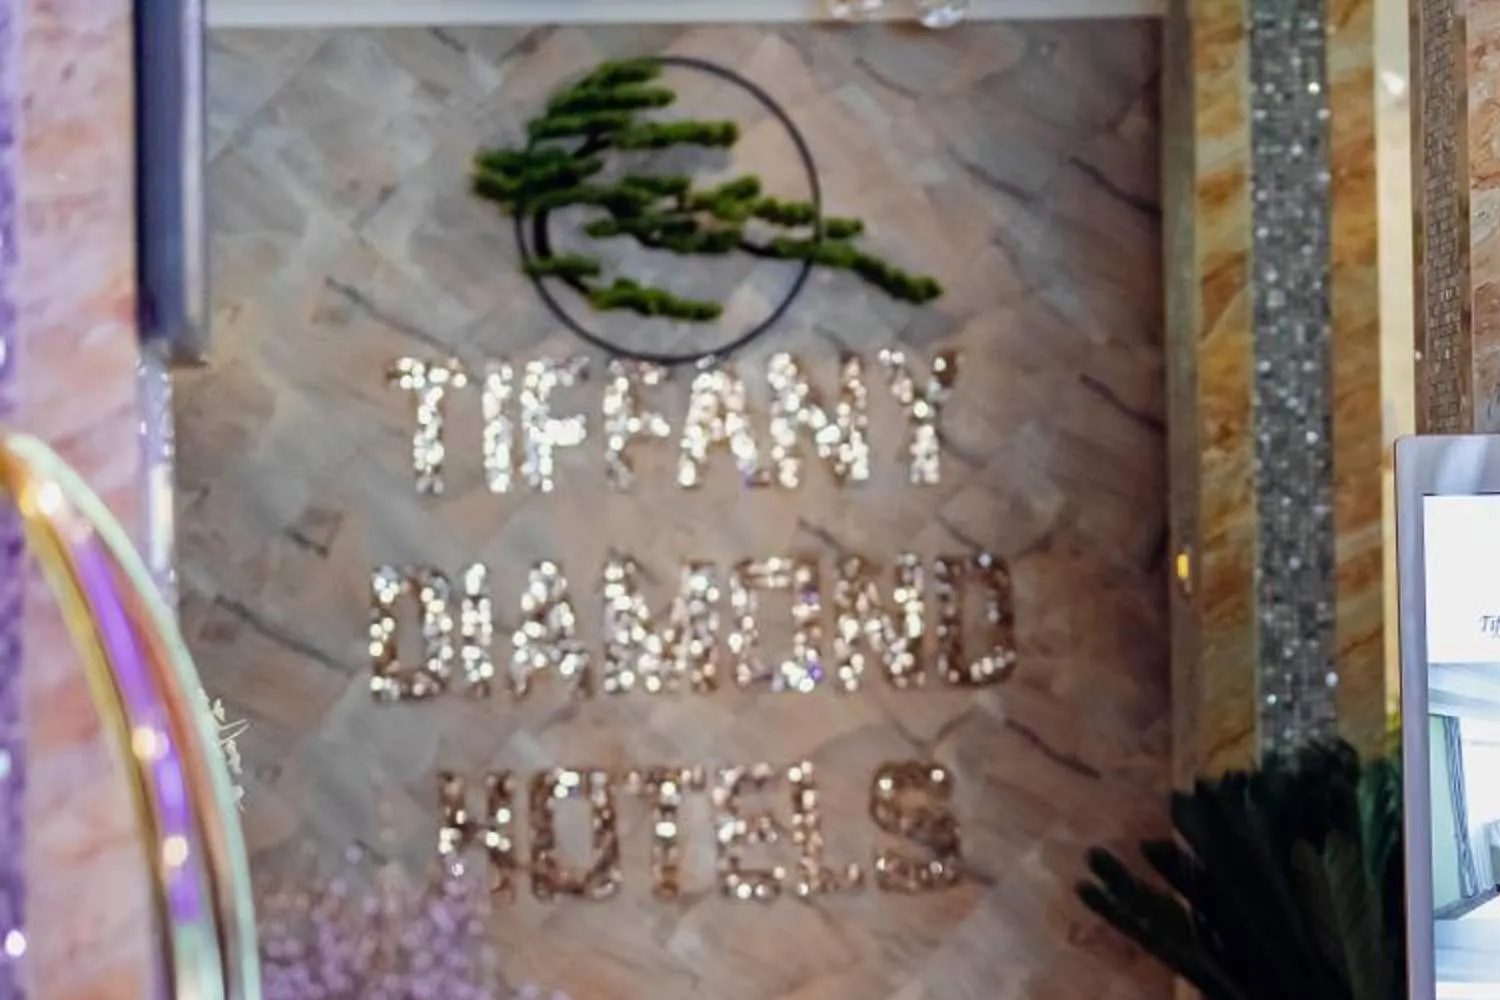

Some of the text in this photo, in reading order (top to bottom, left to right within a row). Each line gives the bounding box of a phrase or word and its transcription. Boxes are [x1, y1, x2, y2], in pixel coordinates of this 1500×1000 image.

[386, 350, 959, 494] TIFFANY
[368, 550, 1017, 700] DIAMOND
[437, 760, 962, 902] HOTELS
